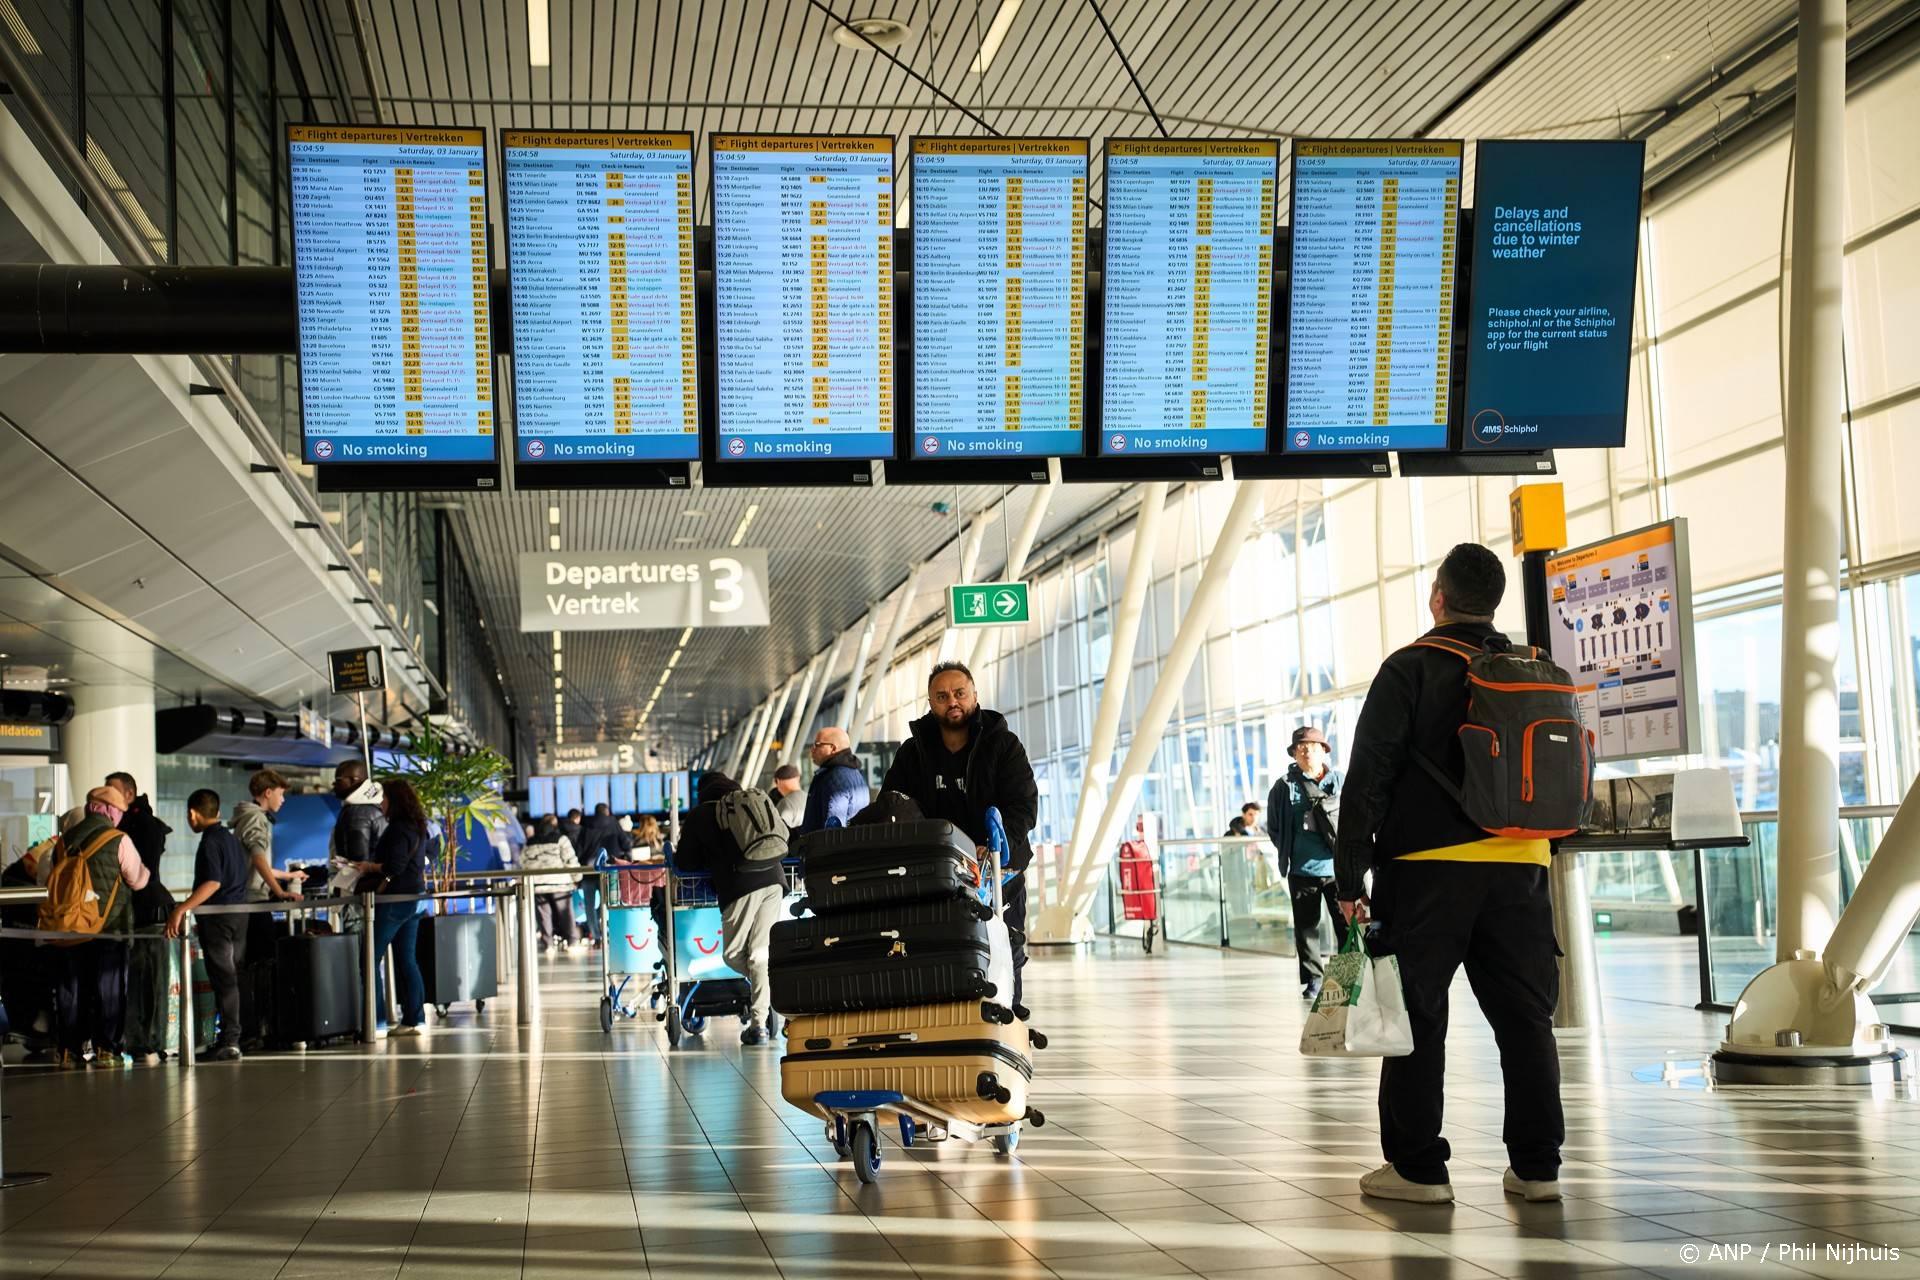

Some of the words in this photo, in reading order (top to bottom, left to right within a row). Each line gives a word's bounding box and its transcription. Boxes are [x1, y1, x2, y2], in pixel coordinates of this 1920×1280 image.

[308, 130, 337, 141] Flight
[341, 131, 398, 142] departures
[406, 133, 463, 142] Vertrekken
[523, 136, 551, 146] Flight
[554, 136, 608, 147] departures
[618, 137, 672, 146] Vertrekken
[731, 140, 758, 149] Flight
[761, 140, 813, 150] departures
[822, 141, 874, 150] Vertrekken
[930, 143, 958, 152] Flight
[960, 143, 1010, 153] departures
[1019, 144, 1070, 152] Vertrekken
[1125, 144, 1151, 153] Flight
[1153, 145, 1202, 154] departures
[1210, 145, 1260, 154] Vertrekken
[1312, 145, 1338, 154] Flight
[1340, 146, 1388, 155] departures
[1396, 146, 1444, 154] Vertrekken
[399, 147, 435, 156] Saturday,
[1495, 207, 1539, 222] Delays
[1544, 207, 1568, 219] and
[1494, 220, 1582, 232] cancellations
[1493, 233, 1518, 245] due
[1522, 234, 1535, 245] to
[1539, 233, 1580, 245] winter
[1492, 247, 1545, 258] weather
[1489, 308, 1521, 316] Please
[1523, 308, 1551, 316] check
[1554, 309, 1576, 318] your
[1578, 307, 1610, 317] airline,
[1488, 319, 1541, 328] schiphol.nl
[1574, 318, 1616, 328] Schiphol
[1487, 331, 1505, 339] app
[1508, 330, 1521, 338] for
[1524, 330, 1539, 338] the
[1542, 330, 1577, 338] current
[1487, 341, 1496, 350] of
[1499, 342, 1521, 351] your
[1523, 340, 1548, 351] flight
[1504, 425, 1538, 434] Schiphol
[948, 440, 965, 450] No
[969, 439, 1023, 452] smoking
[1134, 437, 1151, 448] No
[1155, 436, 1208, 450] smoking
[1318, 435, 1335, 445] No
[1338, 434, 1390, 446] smoking
[343, 444, 362, 456] No
[367, 444, 427, 457] smoking
[554, 444, 573, 455] No
[577, 443, 635, 456] smoking
[754, 442, 772, 453] No
[776, 441, 832, 454] smoking
[546, 562, 700, 590] Departures
[708, 557, 744, 612] 3
[546, 592, 640, 615] Vertrek
[0, 726, 42, 736] lidation
[554, 746, 598, 758] Vertrek
[618, 745, 634, 768] 3
[39, 792, 51, 813] 7
